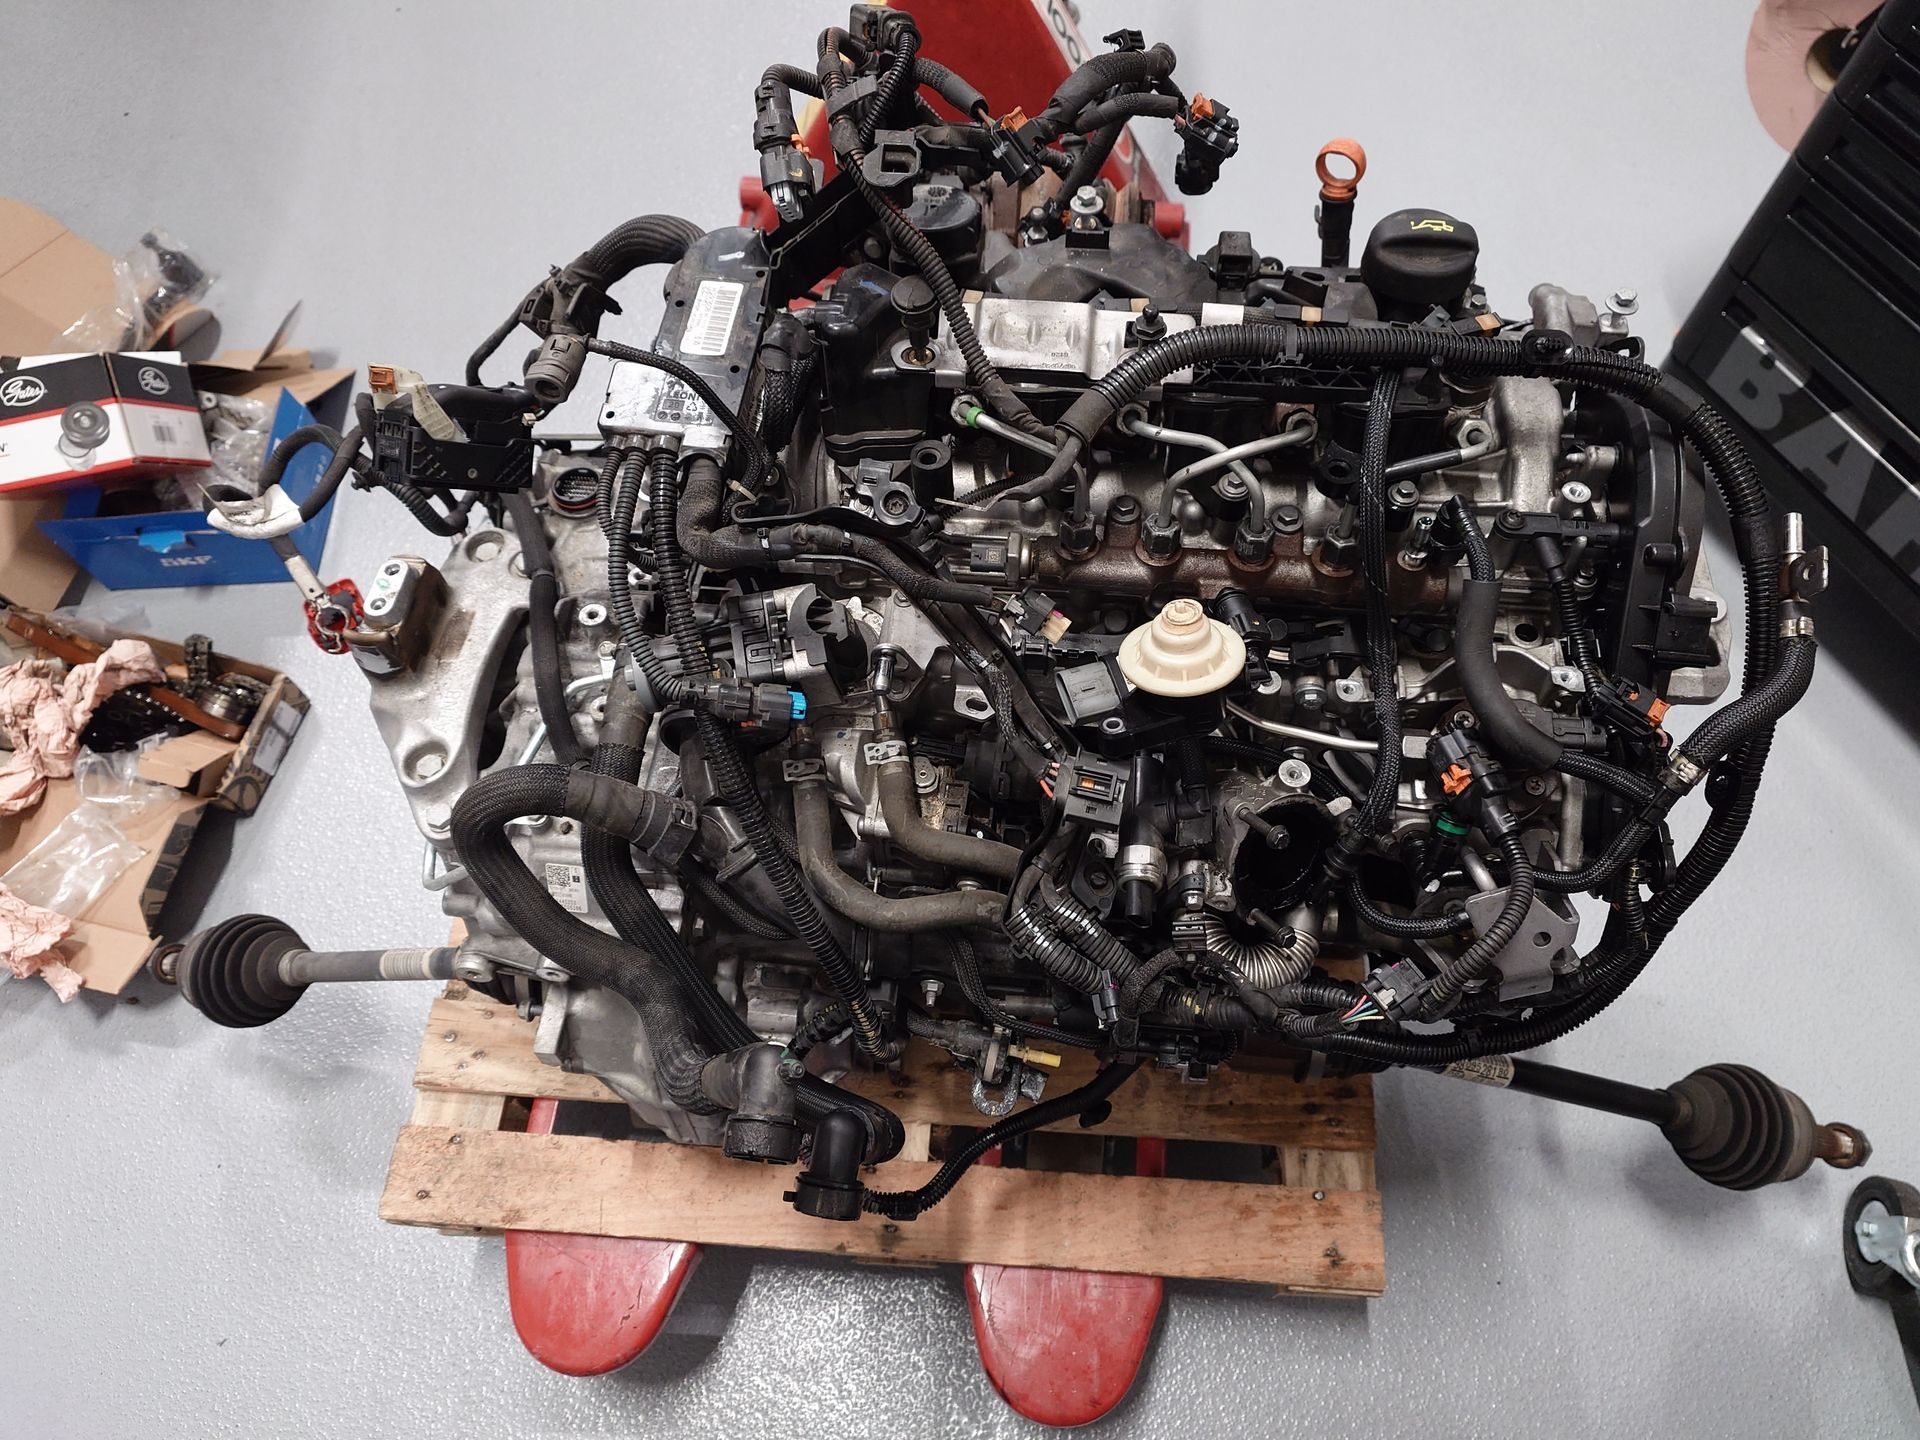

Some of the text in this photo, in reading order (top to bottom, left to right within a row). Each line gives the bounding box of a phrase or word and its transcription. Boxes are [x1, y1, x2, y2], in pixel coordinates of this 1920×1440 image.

[5, 380, 40, 406] Gates
[1706, 326, 1920, 584] BA
[161, 556, 211, 566] SKF
